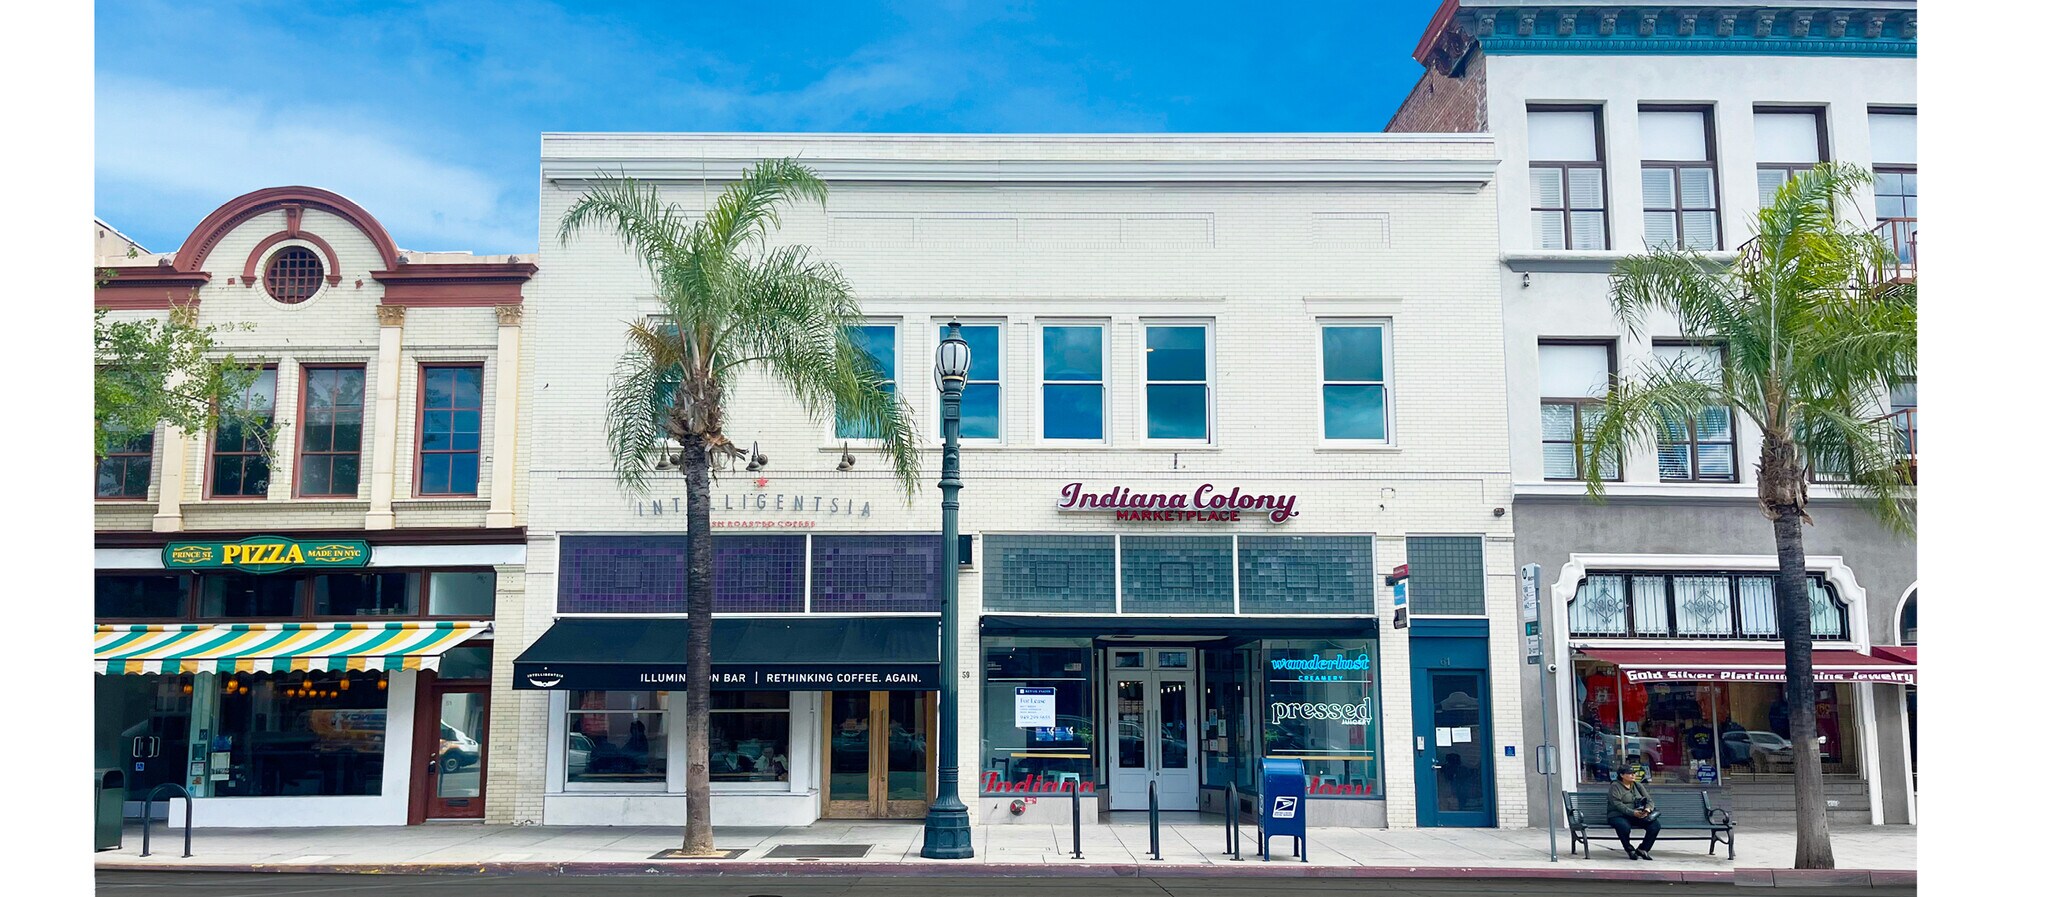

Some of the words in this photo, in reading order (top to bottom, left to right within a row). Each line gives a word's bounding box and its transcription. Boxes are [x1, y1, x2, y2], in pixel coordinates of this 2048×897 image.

[638, 494, 871, 518] INTLIGENTSIA
[1059, 481, 1189, 509] Indiana
[1193, 483, 1300, 523] Colony
[1116, 510, 1241, 522] MARKETPLACE
[172, 550, 200, 559] PRINCE
[202, 550, 214, 559] ST.
[221, 543, 306, 565] PIZZA
[308, 549, 332, 557] MADE
[334, 549, 344, 557] IN
[344, 549, 361, 557] NYC
[1271, 653, 1370, 670] wanderlust
[1440, 657, 1451, 666] 61
[640, 673, 719, 683] ILLUMINN
[723, 673, 746, 683] BAR
[766, 673, 834, 683] RETHINKING
[836, 673, 882, 683] COFFEE.
[885, 673, 922, 683] AGAIN.
[1627, 670, 1663, 680] Gold
[1667, 671, 1715, 680] Silver
[1850, 672, 1914, 684] Jewelry
[1271, 697, 1373, 725] pressed
